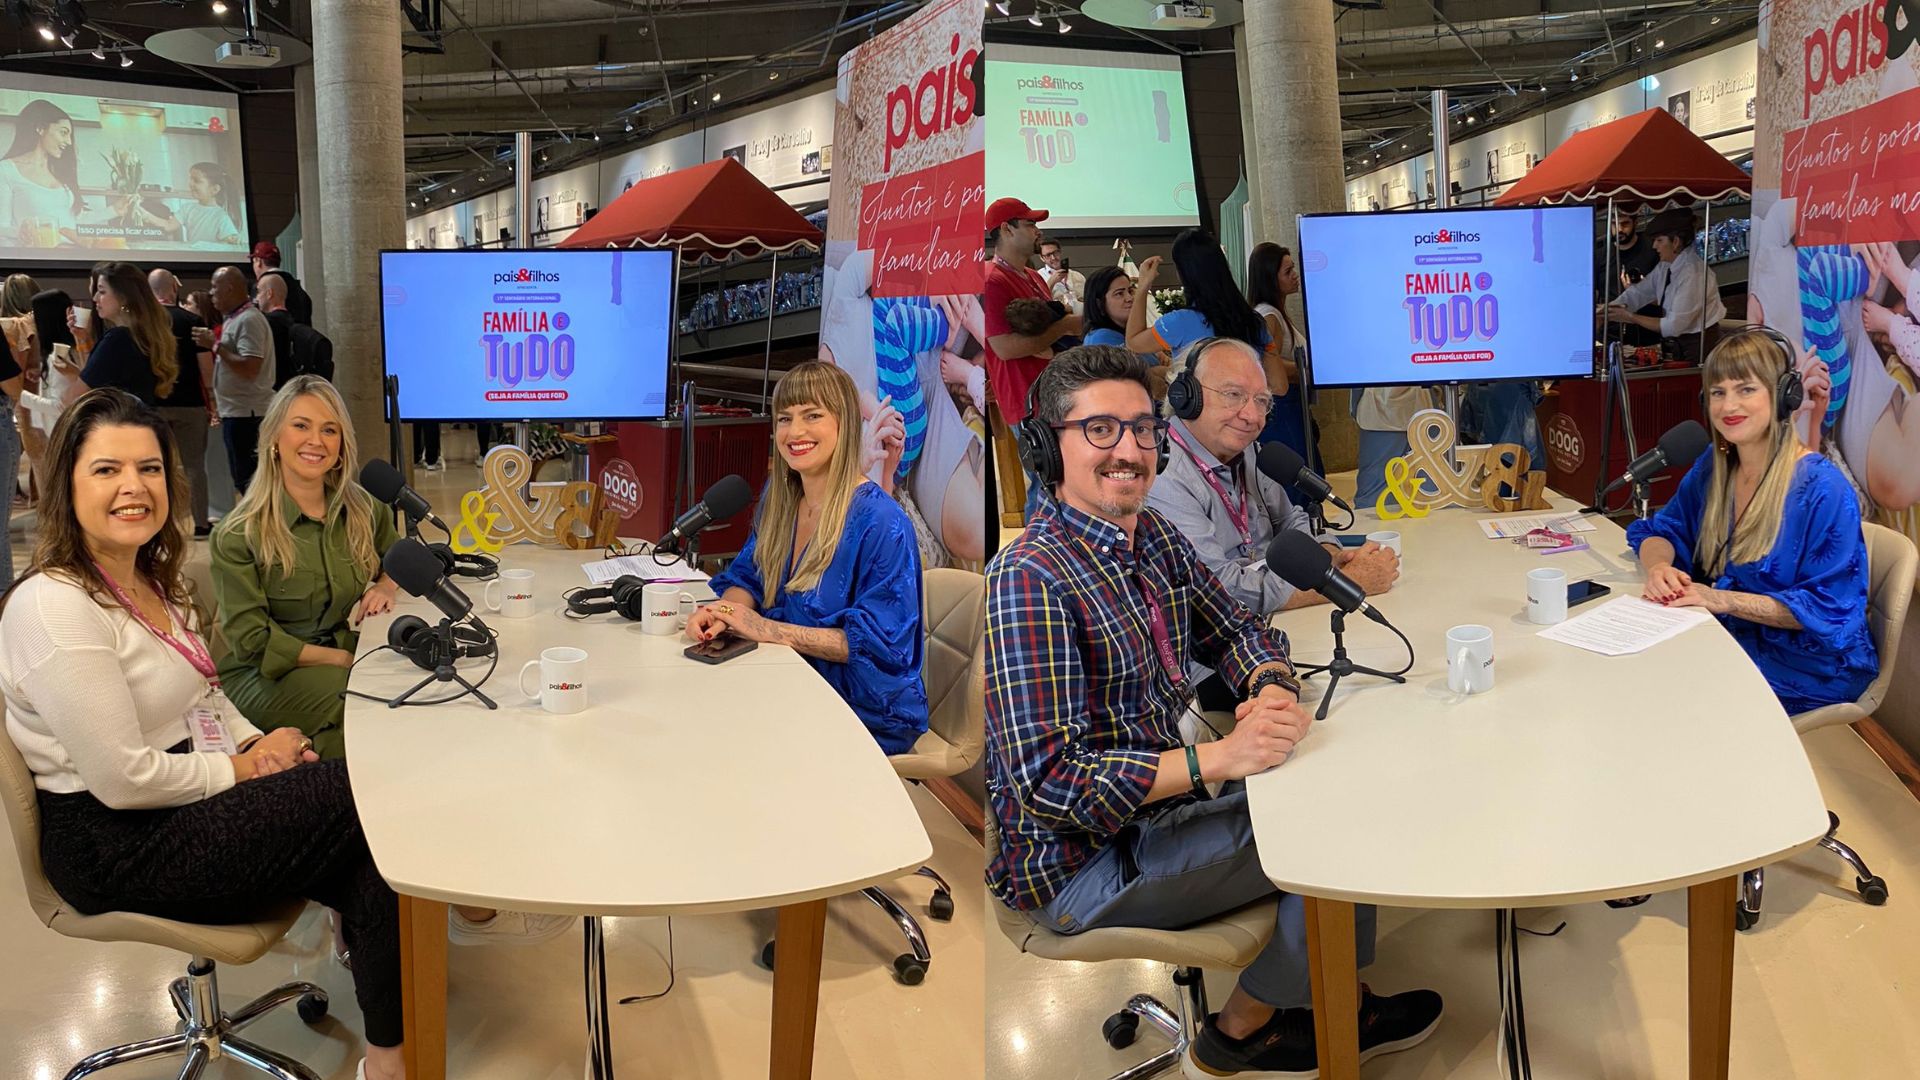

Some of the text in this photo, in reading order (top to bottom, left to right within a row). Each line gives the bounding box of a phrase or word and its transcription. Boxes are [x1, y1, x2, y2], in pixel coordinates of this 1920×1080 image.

[1017, 75, 1084, 90] pais&filhos
[884, 33, 985, 173] pais
[1020, 107, 1073, 127] FAMÍLIA
[1786, 124, 1854, 196] Juntos
[1861, 127, 1872, 154] é
[863, 174, 937, 249] Juntos
[944, 181, 956, 209] é
[1800, 172, 1883, 237] famílias
[78, 226, 94, 234] Isso
[96, 227, 124, 235] precisa
[1414, 229, 1480, 246] pais&filhos
[877, 226, 966, 288] famílias
[494, 268, 560, 285] pais&filhos
[1405, 269, 1472, 295] FAMÍLIA
[483, 308, 549, 332] FAMÍLIA
[1402, 294, 1499, 350] TUDO
[479, 334, 575, 388] TUDO
[1439, 353, 1462, 361] FAMÍLIA
[1549, 427, 1578, 456] DOOG
[604, 472, 637, 501] DOOG
